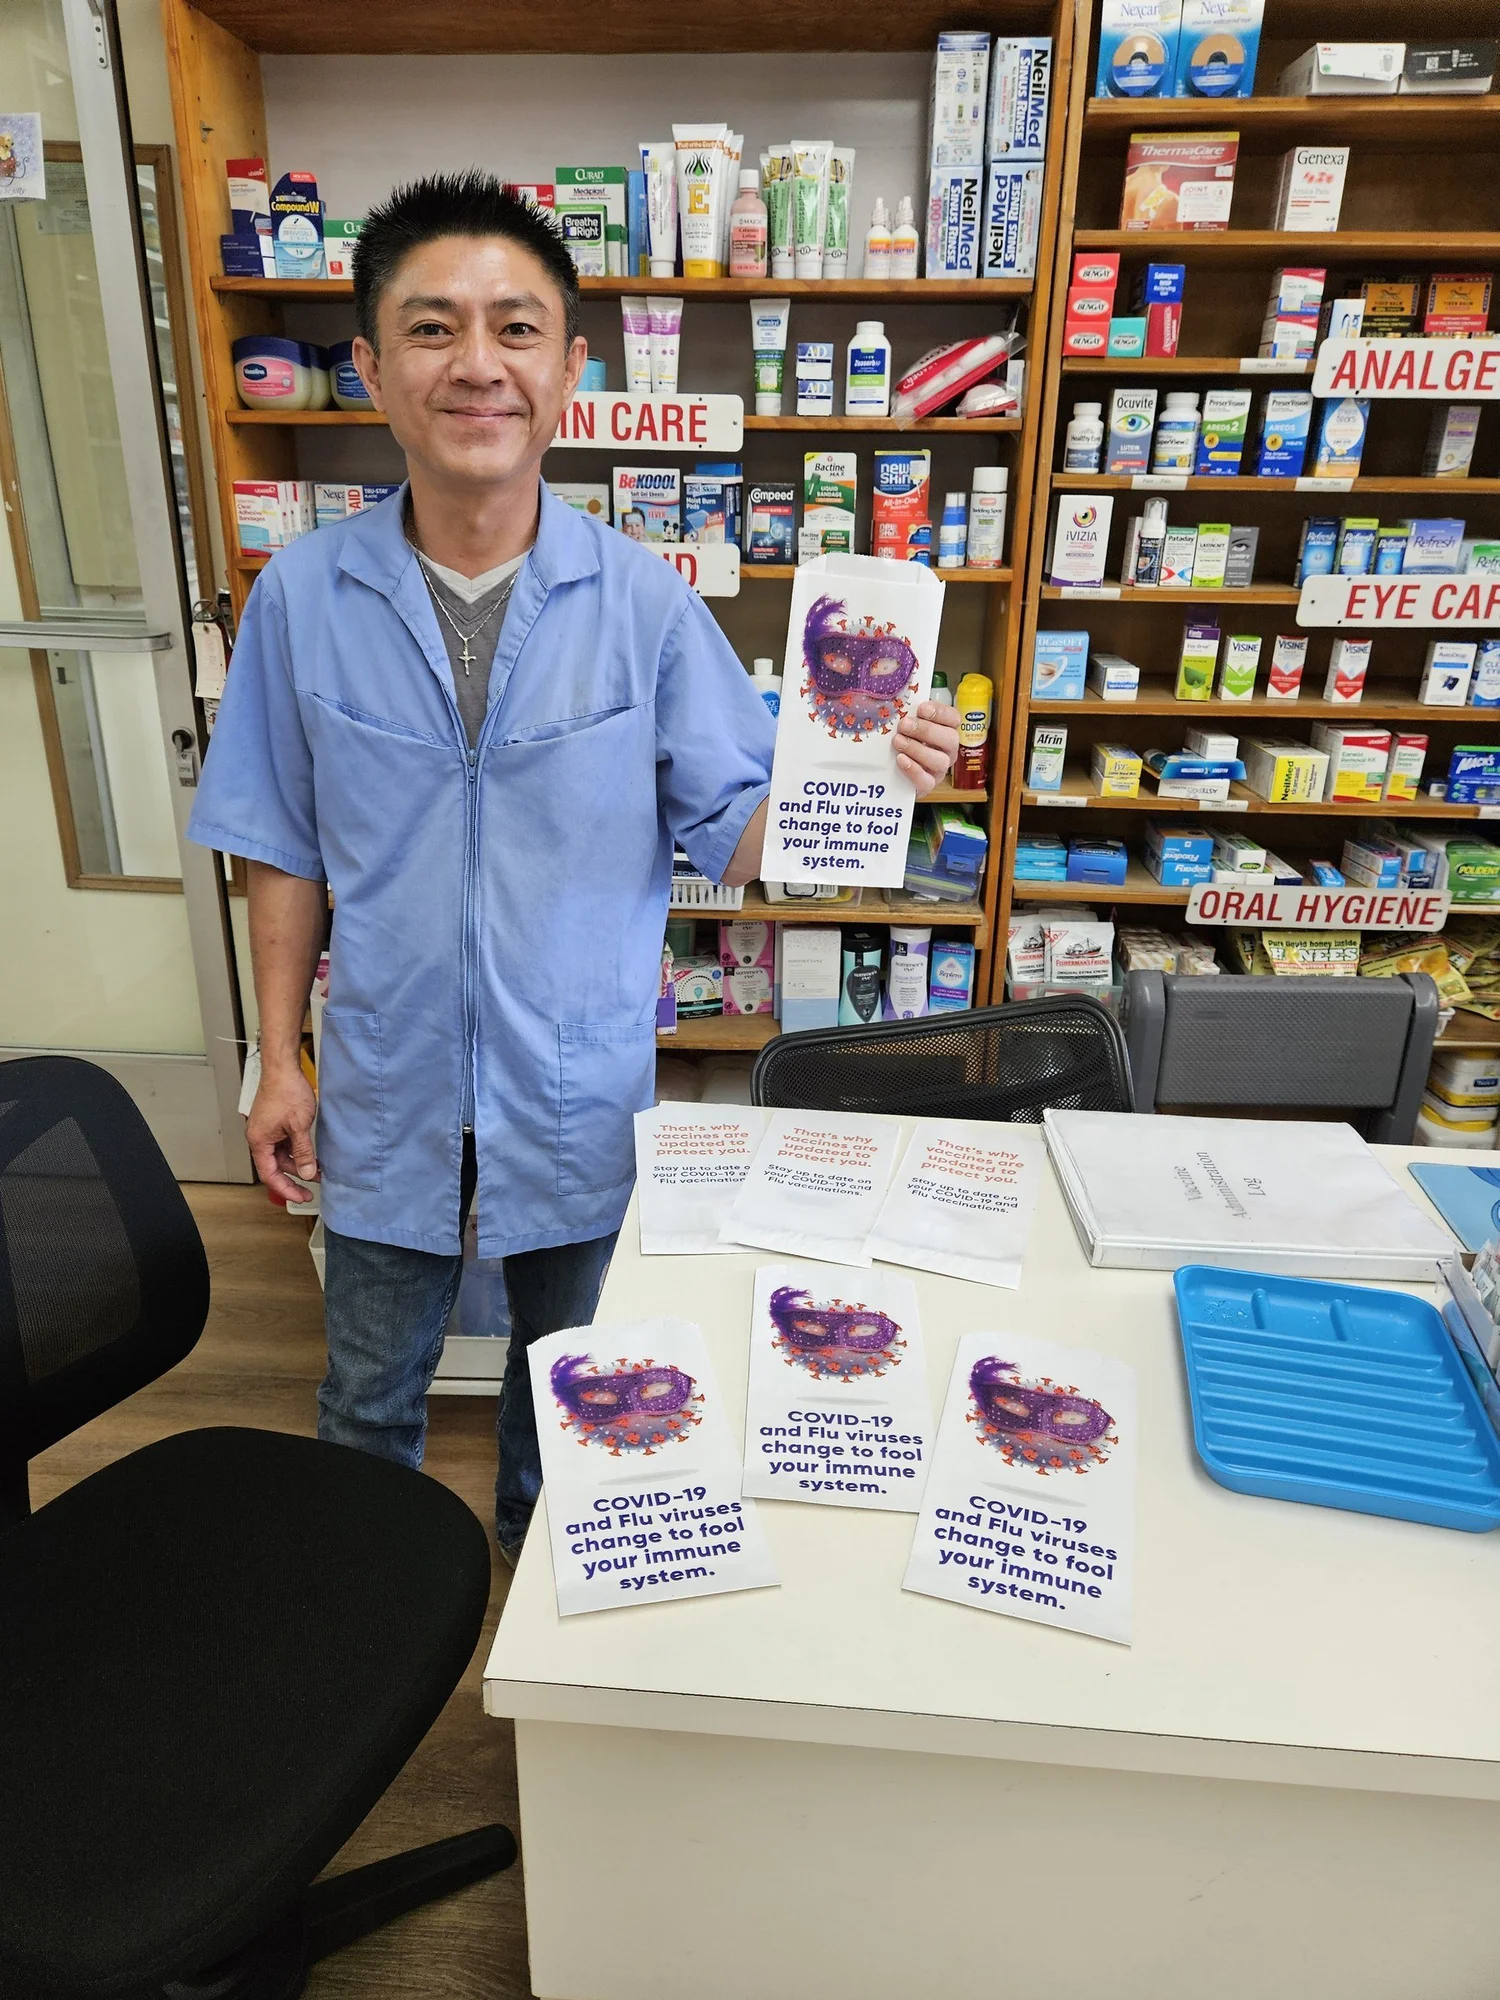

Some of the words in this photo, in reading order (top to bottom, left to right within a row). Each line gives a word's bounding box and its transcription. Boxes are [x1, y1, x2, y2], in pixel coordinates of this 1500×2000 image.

[1018, 56, 1031, 98] SINUS
[1028, 49, 1048, 148] NeilMed
[1015, 101, 1028, 140] RINSE
[1142, 145, 1226, 156] ThermaCare
[1297, 150, 1345, 166] Genexa
[575, 168, 604, 181] CURAD
[271, 202, 310, 213] Compound
[310, 202, 320, 214] W
[688, 184, 710, 214] E
[948, 186, 961, 224] SINUS
[1009, 180, 1022, 218] RINSE
[565, 217, 598, 226] Breathe
[960, 178, 978, 270] NeilMed
[988, 175, 1008, 268] NeilMed
[576, 226, 598, 238] Right
[1004, 220, 1016, 262] SINUS
[946, 226, 958, 265] RINSE
[1330, 350, 1500, 391] ANALGE
[1117, 397, 1154, 410] Ocuvite
[560, 401, 595, 440] IN
[611, 402, 708, 443] CARE
[1231, 421, 1239, 432] 2
[814, 463, 845, 472] Bactine
[880, 464, 910, 474] new
[619, 474, 676, 490] BeKOOOL
[750, 488, 794, 503] Compeed
[1066, 530, 1098, 542] iVIZIA
[1306, 532, 1337, 542] Refresh
[1344, 532, 1375, 543] Refresh
[1378, 538, 1406, 548] Refresh
[1414, 536, 1456, 548] Refresh
[1345, 584, 1420, 620] EYE
[1233, 642, 1258, 652] VISINE
[1278, 640, 1305, 650] VISINE
[1344, 645, 1370, 654] VISINE
[1037, 734, 1063, 745] Afrin
[1280, 760, 1294, 800] NeilMed
[803, 782, 885, 798] COVID-19
[779, 801, 811, 813] and
[817, 801, 840, 815] Flu
[845, 803, 903, 818] viruses
[779, 818, 841, 836] change
[846, 822, 862, 834] to
[866, 822, 898, 836] fool
[782, 838, 820, 850] your
[825, 838, 889, 853] immune
[802, 855, 865, 870] system.
[1163, 853, 1199, 862] Fixodent
[1174, 864, 1210, 873] Fixodent
[1198, 890, 1284, 922] ORAL
[1296, 894, 1442, 926] HYGIENE
[1310, 940, 1332, 948] honey
[1056, 959, 1090, 967] FISHERMAN'S
[939, 970, 962, 979] Replens
[659, 1140, 725, 1148] updated
[783, 1134, 847, 1149] vaccines
[853, 1144, 878, 1152] are
[794, 1128, 838, 1140] That's
[843, 1135, 872, 1144] why
[656, 1148, 713, 1156] protect
[718, 1147, 751, 1155] you.
[785, 1143, 850, 1157] updated
[856, 1151, 870, 1159] to
[926, 1146, 993, 1164] vaccines
[937, 1139, 982, 1155] That's
[988, 1150, 1019, 1160] why
[778, 1150, 835, 1163] protect
[839, 1158, 872, 1168] you.
[929, 1155, 995, 1173] updated
[1001, 1167, 1017, 1175] to
[763, 1170, 788, 1178] your
[792, 1174, 846, 1187] COVID-19
[850, 1183, 872, 1191] and
[769, 1164, 792, 1173] Stay
[828, 1174, 854, 1183] date
[921, 1162, 980, 1179] protect
[984, 1175, 1018, 1184] you.
[768, 1177, 784, 1185] Flu
[788, 1181, 863, 1196] vaccinations.
[912, 1177, 937, 1187] Stay
[973, 1189, 1000, 1199] date
[1174, 1165, 1204, 1202] Vaccine
[1196, 1151, 1248, 1218] Administration
[1243, 1176, 1267, 1198] Log
[907, 1183, 933, 1192] your
[936, 1189, 992, 1204] COVID-19
[995, 1199, 1018, 1208] and
[911, 1190, 928, 1198] Flu
[932, 1196, 1009, 1213] vaccinations.
[788, 1411, 893, 1428] COVID-19
[760, 1426, 800, 1437] and
[809, 1427, 838, 1439] Flu
[845, 1430, 923, 1445] viruses
[762, 1441, 844, 1459] change
[851, 1446, 873, 1458] to
[881, 1447, 922, 1461] fool
[770, 1462, 818, 1474] your
[826, 1460, 915, 1478] immune
[799, 1479, 887, 1494] system.
[593, 1486, 706, 1512] COVID-19
[565, 1516, 612, 1535] and
[619, 1512, 653, 1527] Flu
[659, 1502, 742, 1523] viruses
[969, 1495, 1087, 1534] COVID-19
[571, 1532, 662, 1555] change
[669, 1528, 693, 1540] to
[699, 1516, 744, 1537] fool
[935, 1508, 981, 1526] and
[989, 1517, 1023, 1537] Flu
[1031, 1531, 1117, 1560] viruses
[583, 1554, 637, 1579] your
[645, 1541, 741, 1564] immune
[934, 1526, 1025, 1556] change
[1033, 1549, 1058, 1565] to
[1066, 1555, 1113, 1580] fool
[619, 1566, 715, 1590] system.
[939, 1549, 994, 1570] your
[1001, 1559, 1102, 1599] immune
[968, 1576, 1066, 1610] system.
